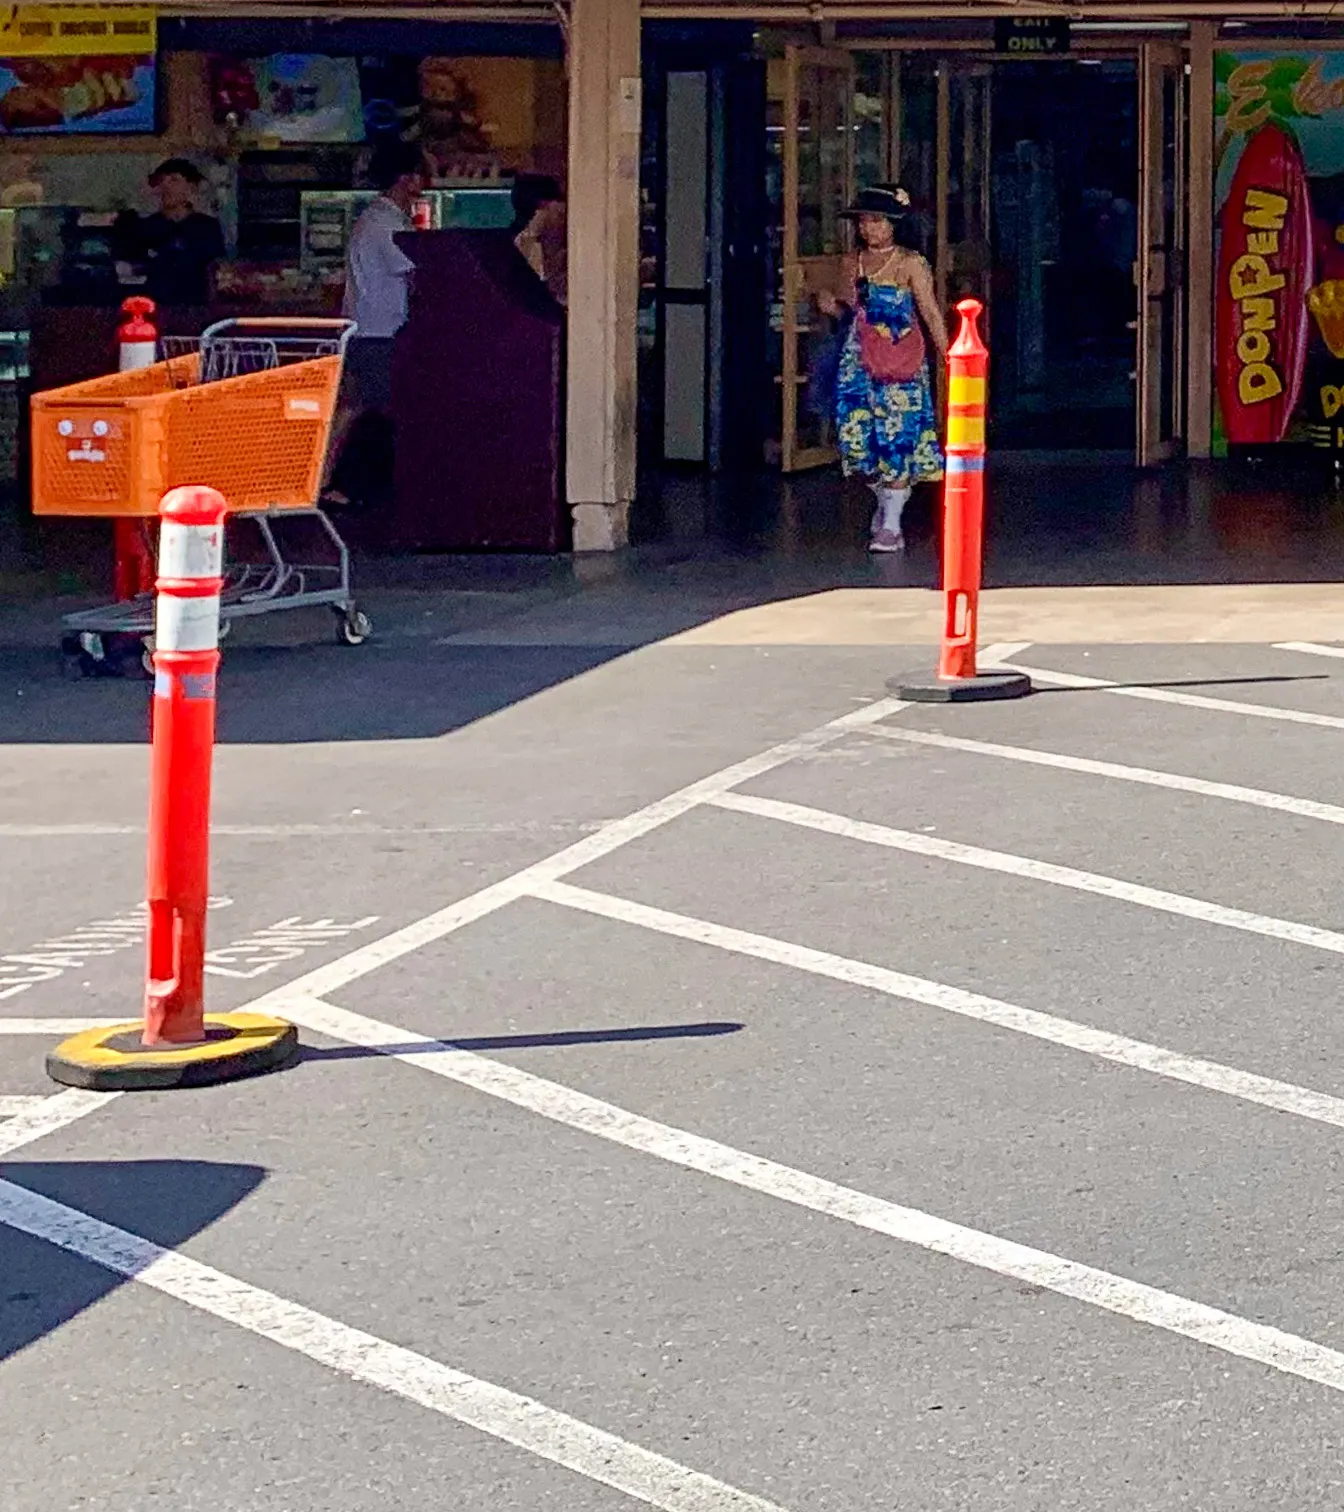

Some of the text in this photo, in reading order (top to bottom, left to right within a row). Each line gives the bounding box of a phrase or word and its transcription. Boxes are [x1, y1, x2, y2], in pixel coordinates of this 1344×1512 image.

[1008, 37, 1056, 50] ONLY
[1226, 59, 1273, 132] E
[1229, 189, 1288, 405] DONPEN
